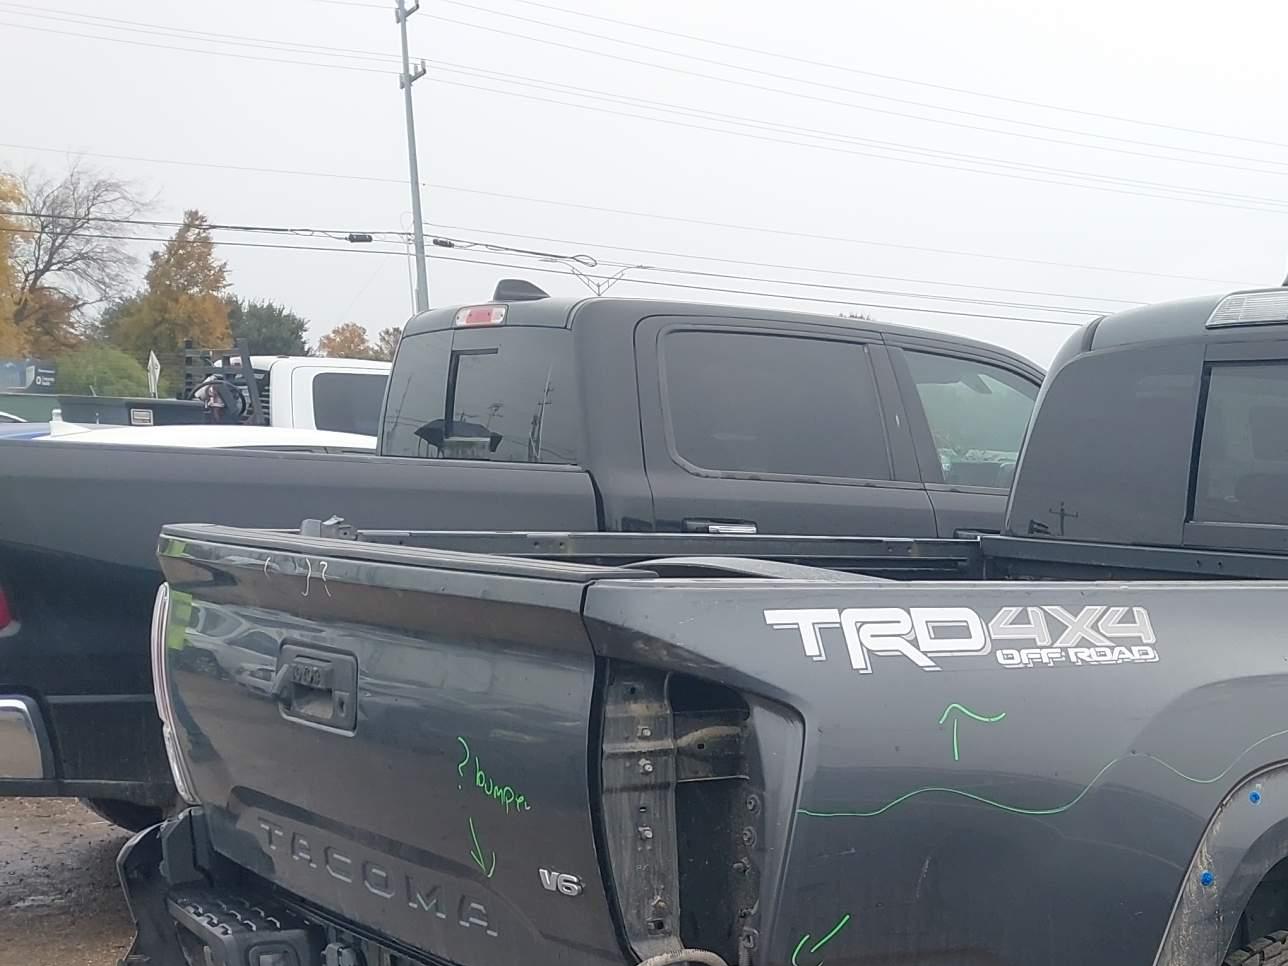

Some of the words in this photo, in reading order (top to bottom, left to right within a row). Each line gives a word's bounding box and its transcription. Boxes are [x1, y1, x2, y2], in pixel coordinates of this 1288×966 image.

[763, 607, 991, 674] TRD
[988, 605, 1157, 647] 4X4
[996, 647, 1066, 668] OFF
[1069, 645, 1160, 668] ROAD
[257, 816, 498, 937] TACOMA
[538, 868, 584, 897] V6
